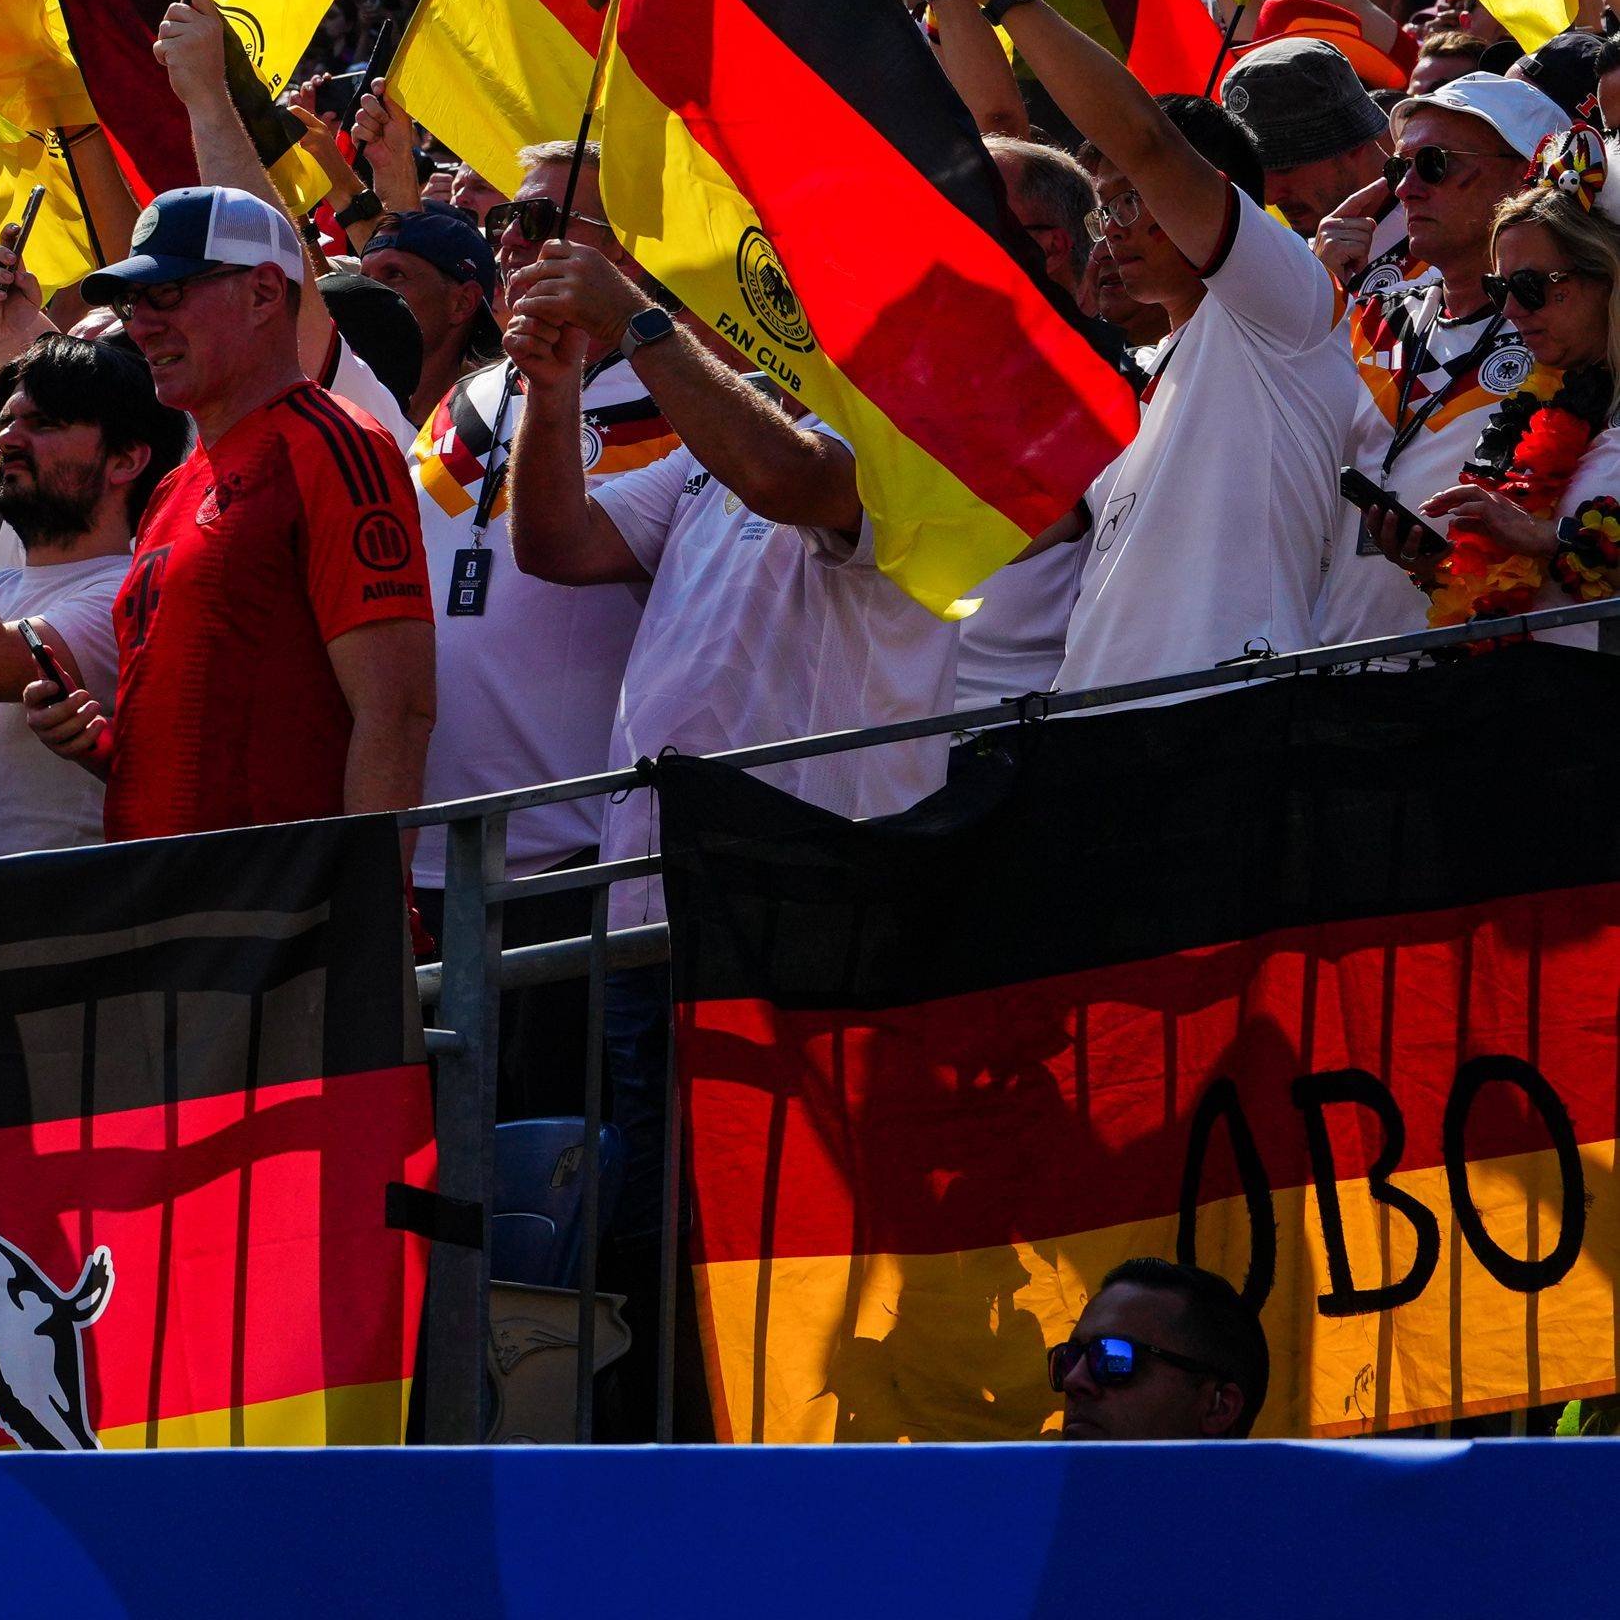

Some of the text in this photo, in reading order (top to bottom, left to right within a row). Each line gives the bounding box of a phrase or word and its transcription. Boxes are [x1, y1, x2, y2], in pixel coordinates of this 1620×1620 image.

[716, 312, 802, 393] FAN CLUB
[362, 580, 425, 602] Allianz
